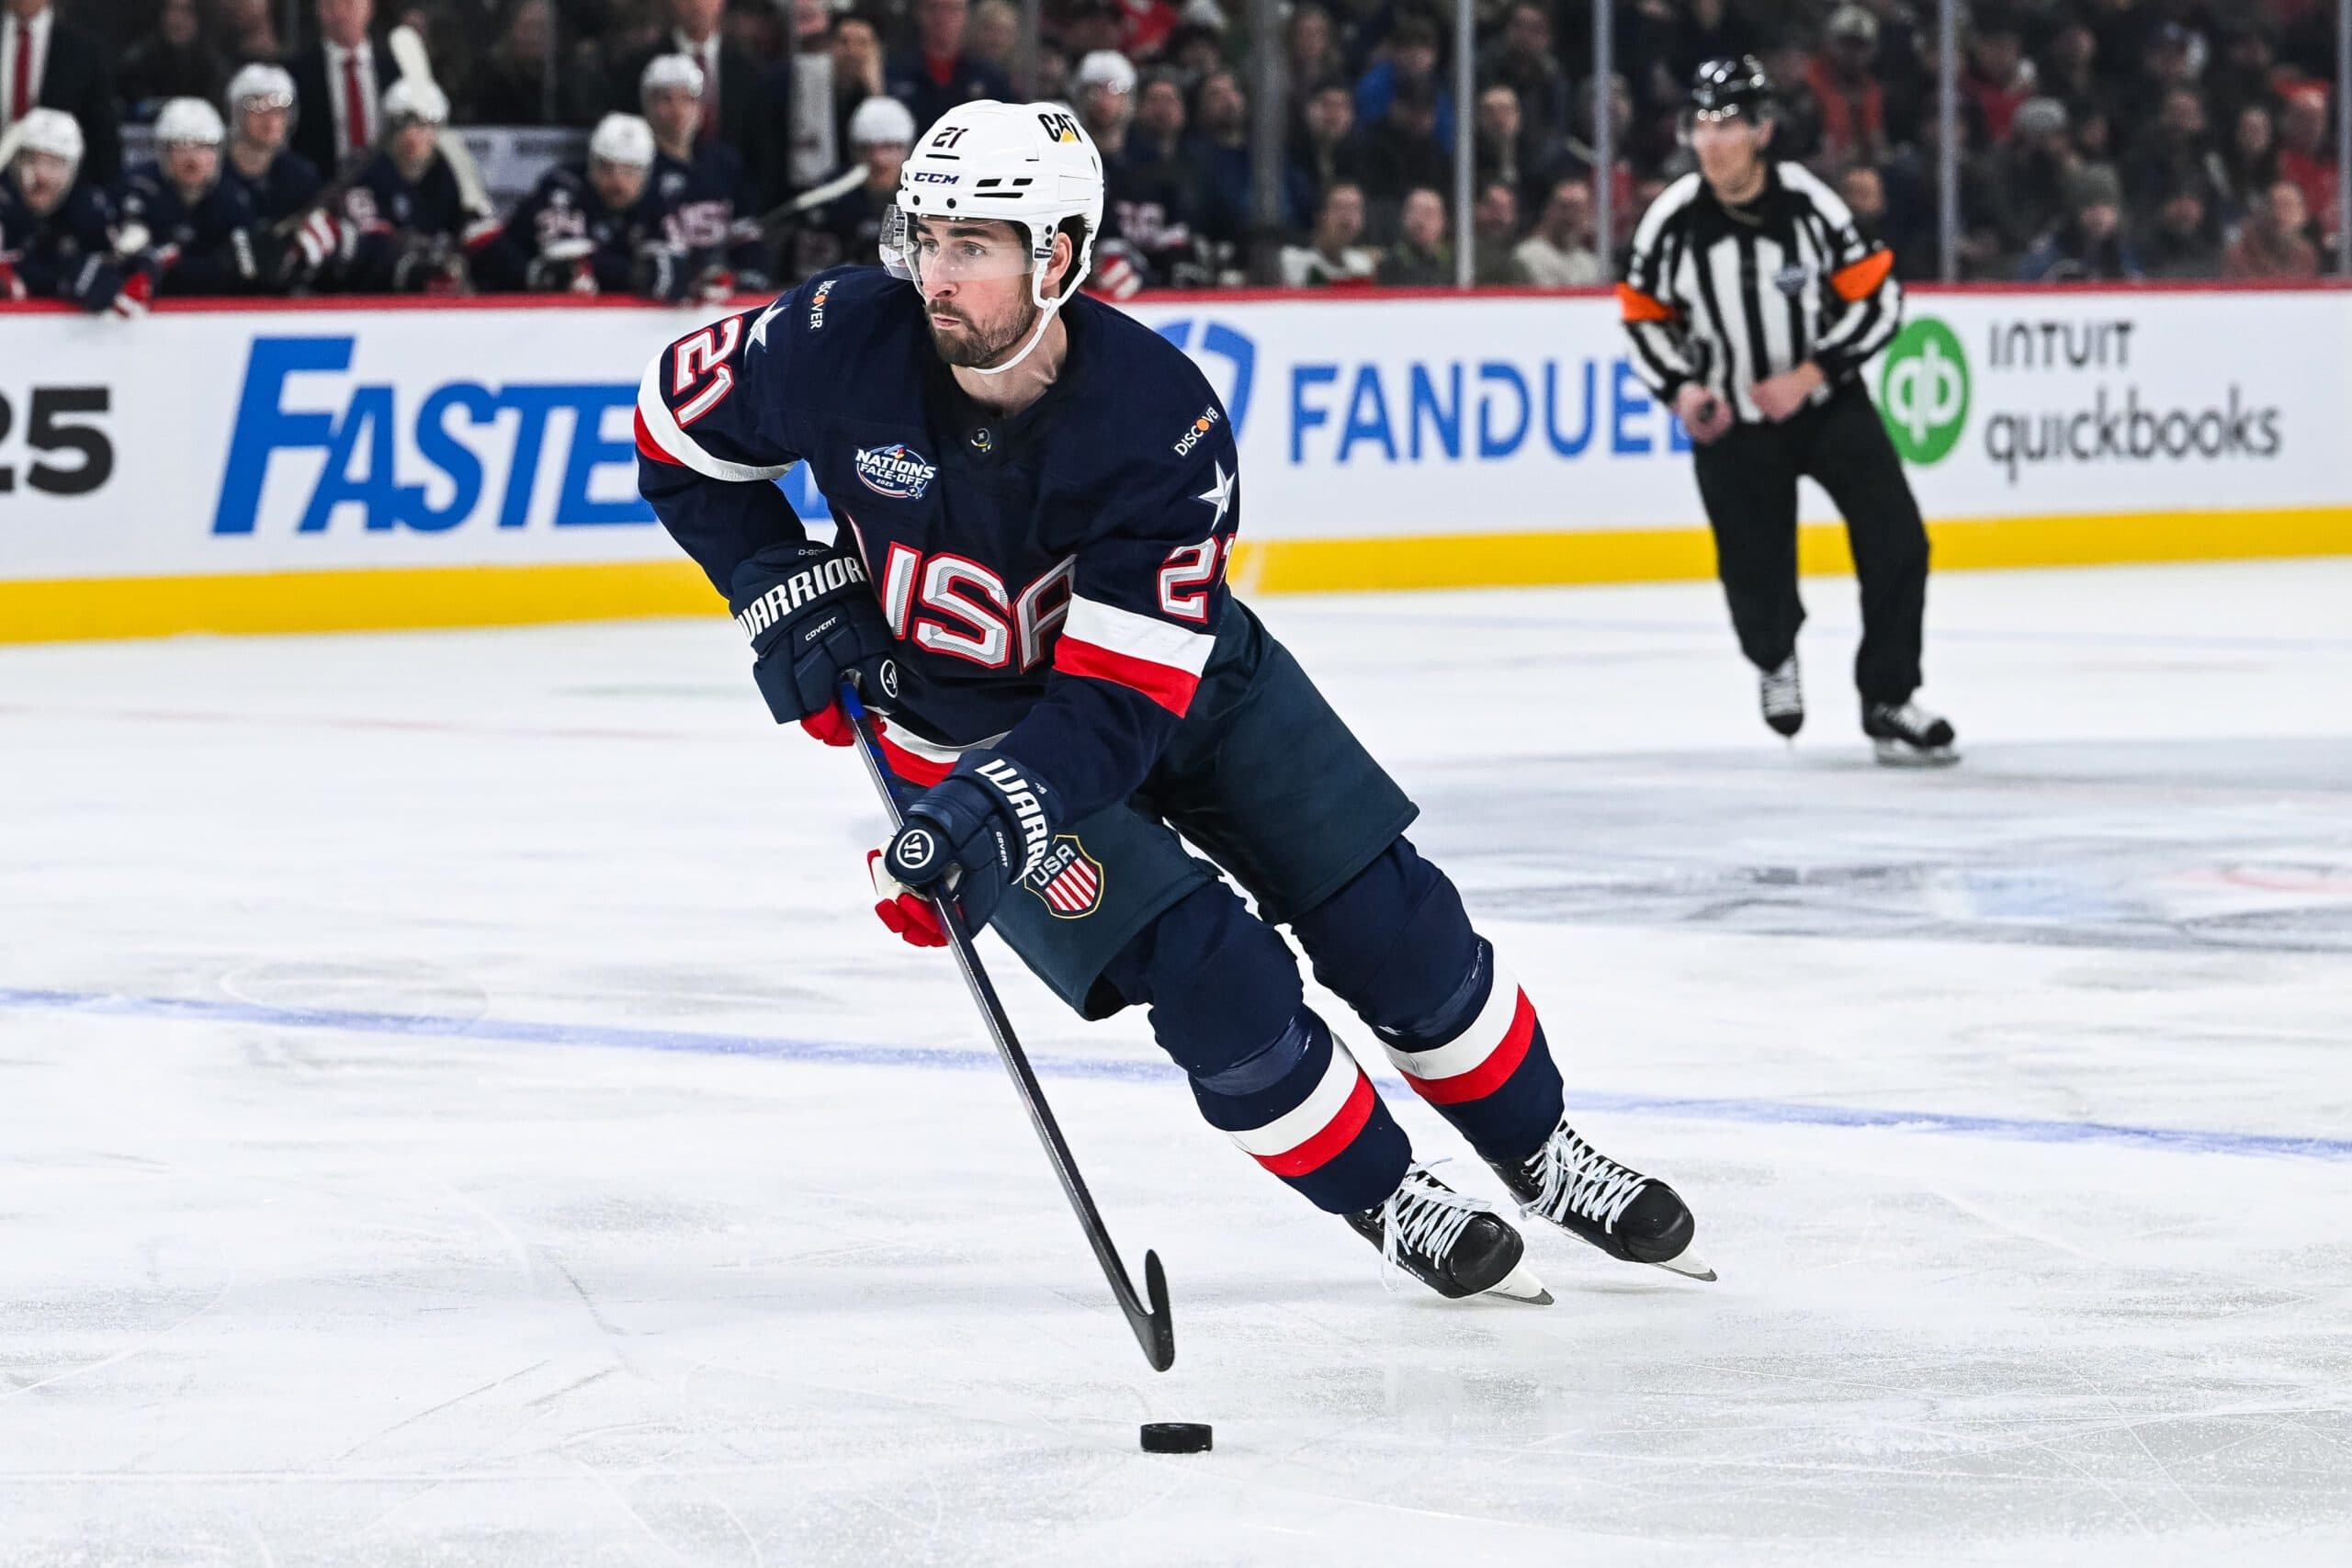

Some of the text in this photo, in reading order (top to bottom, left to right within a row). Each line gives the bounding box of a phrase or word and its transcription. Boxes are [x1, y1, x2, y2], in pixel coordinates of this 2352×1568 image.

[932, 127, 970, 149] 21
[1038, 113, 1083, 143] CAT
[913, 172, 960, 185] CCM
[673, 314, 742, 428] 21
[0, 386, 116, 497] 5
[211, 334, 657, 536] FASTE
[1984, 385, 2281, 482] quickbooks
[855, 448, 936, 479] NATIONS
[859, 463, 925, 487] FACE-OFF
[876, 479, 895, 488] 2025
[805, 616, 838, 641] COVERT
[975, 759, 1048, 885] WARR
[995, 831, 1009, 868] COVERT
[1031, 843, 1077, 887] USA
